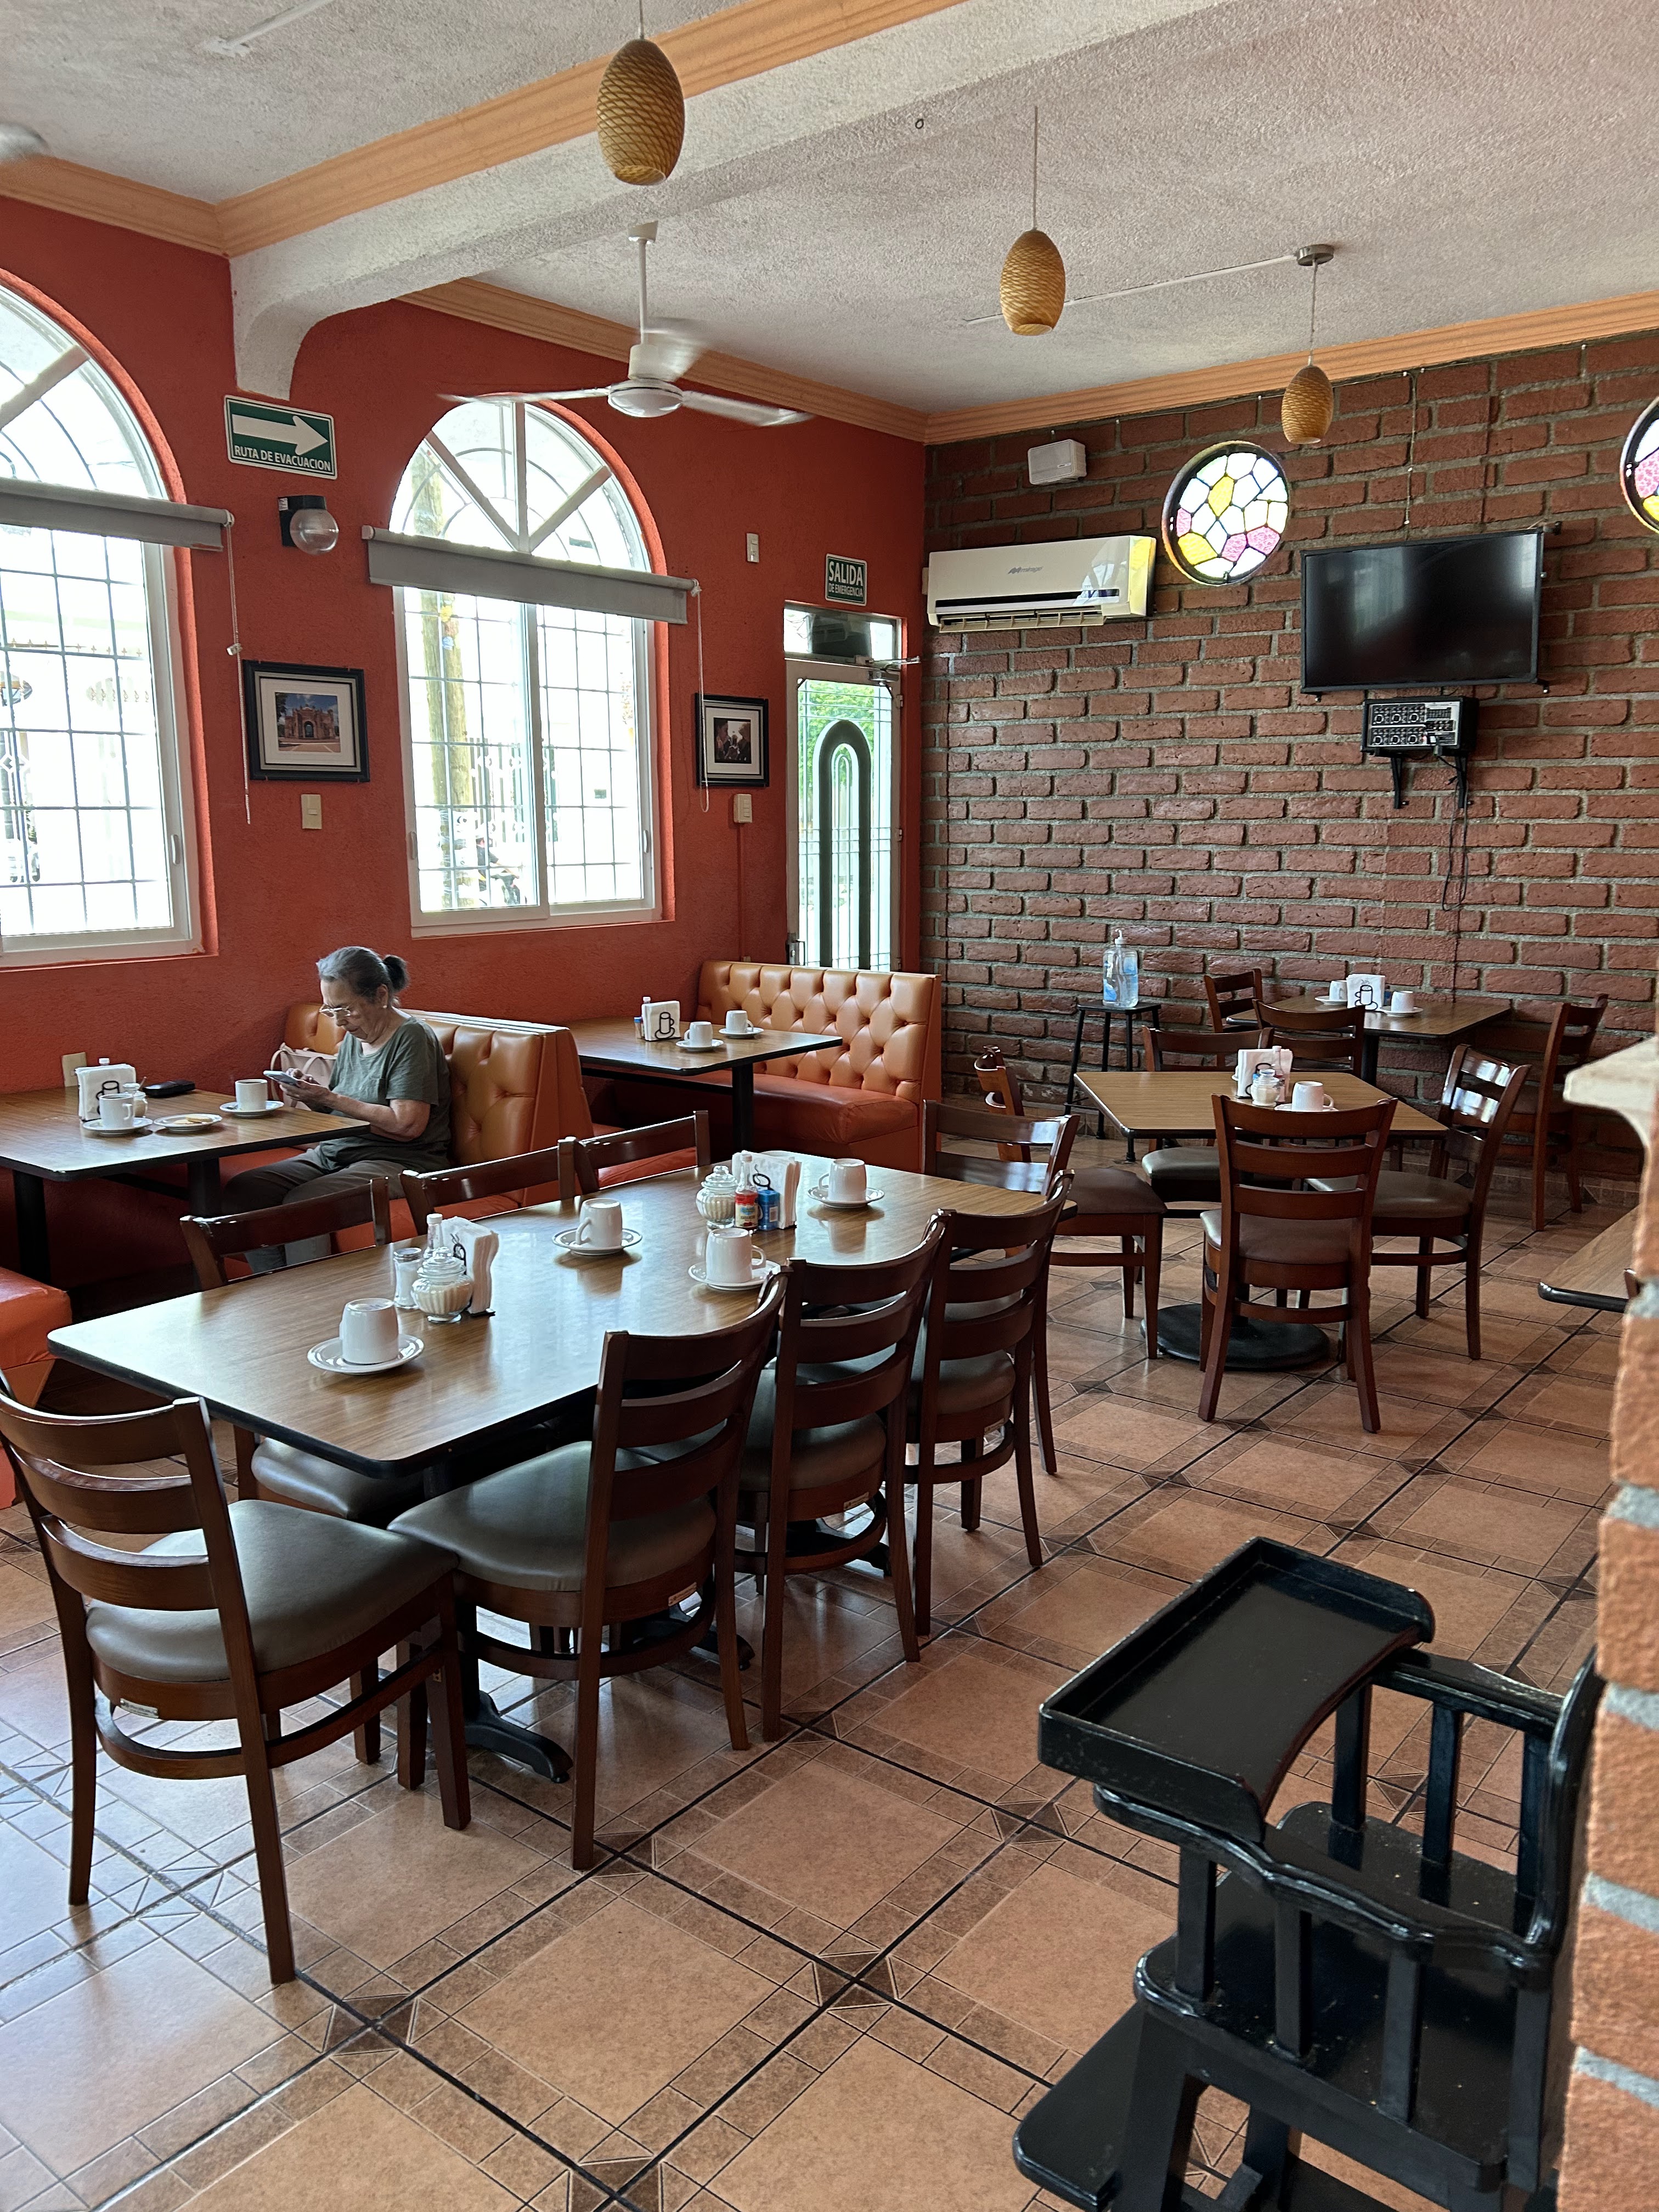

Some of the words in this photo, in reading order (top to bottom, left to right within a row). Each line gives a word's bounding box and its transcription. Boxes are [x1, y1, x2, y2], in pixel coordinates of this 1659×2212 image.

[234, 445, 259, 459] RUTA
[260, 450, 273, 461] DE
[275, 453, 331, 470] EVACUACION
[828, 561, 863, 586] SALIDA
